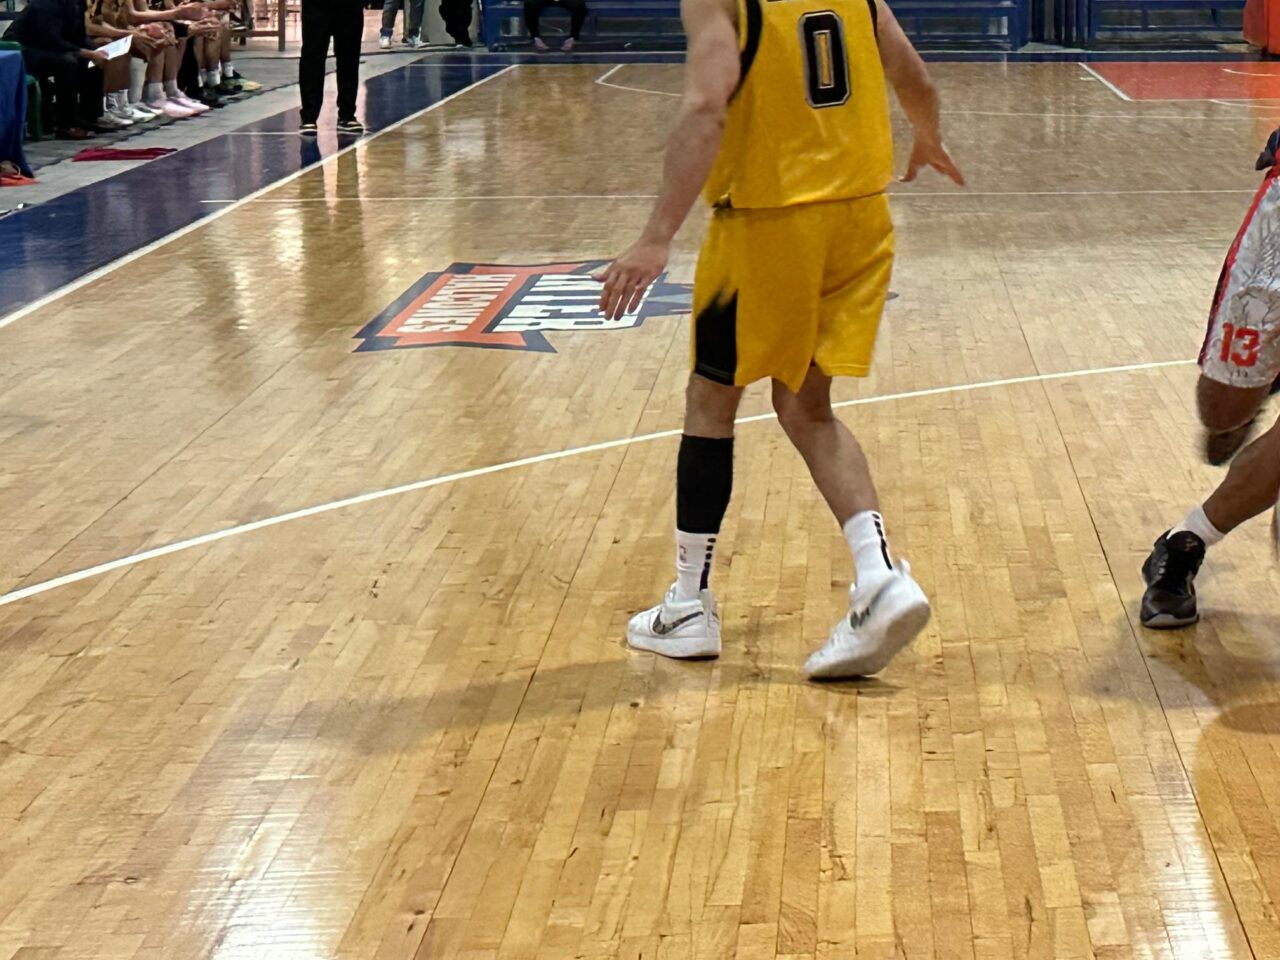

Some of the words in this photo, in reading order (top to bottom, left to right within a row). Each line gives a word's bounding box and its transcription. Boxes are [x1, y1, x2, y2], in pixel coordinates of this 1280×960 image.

[799, 10, 850, 107] 0
[396, 274, 516, 332] HALCONES
[1220, 322, 1260, 368] 13
